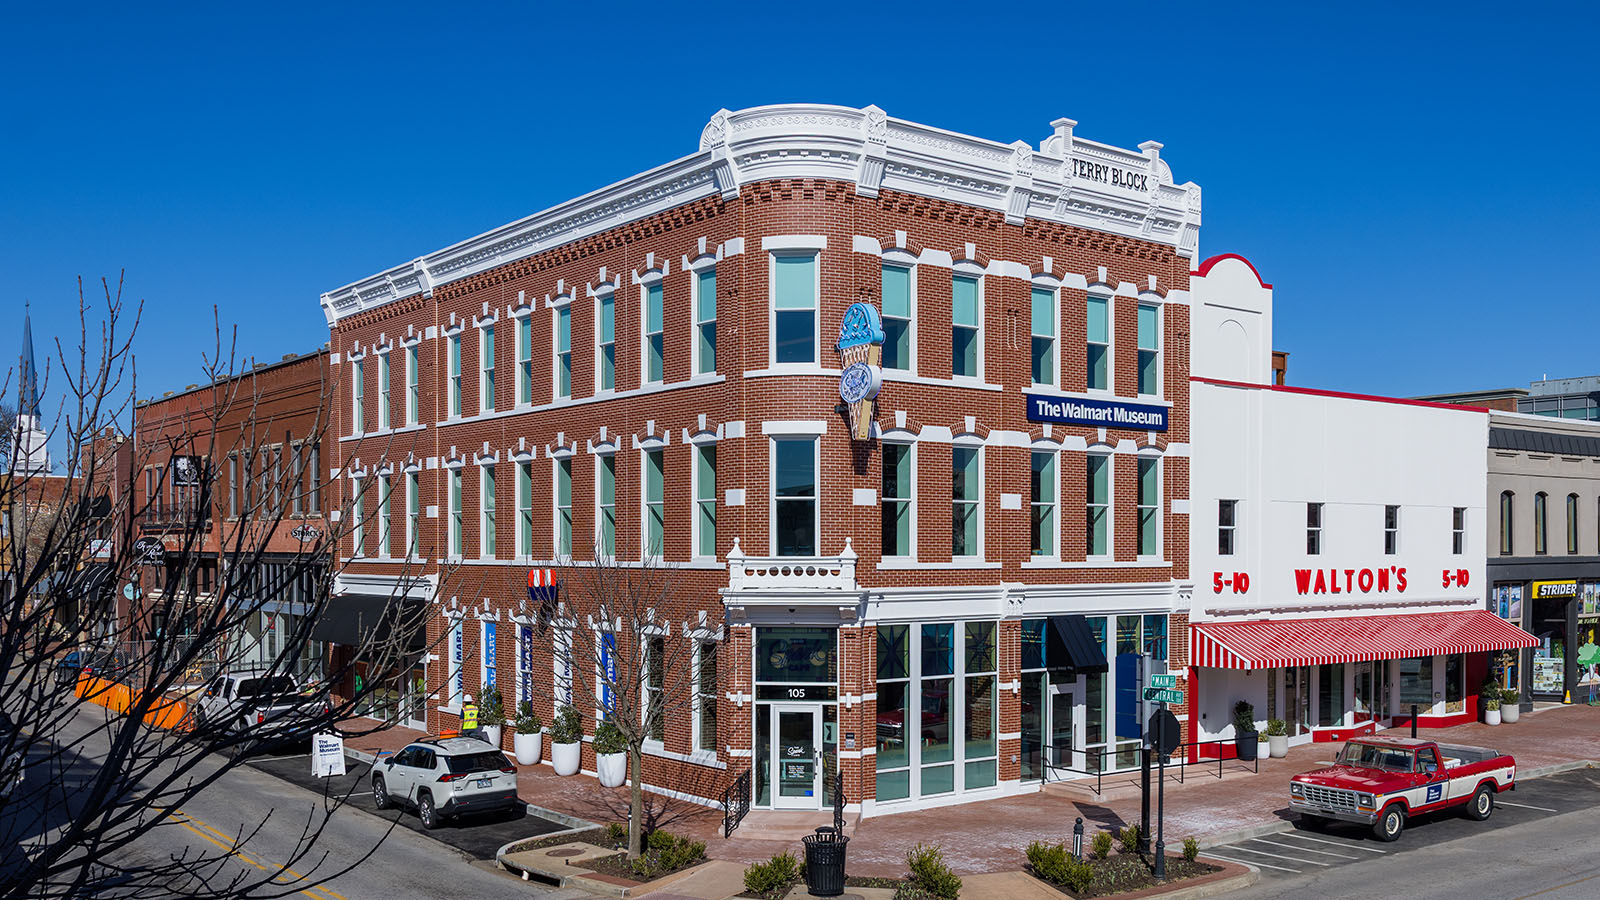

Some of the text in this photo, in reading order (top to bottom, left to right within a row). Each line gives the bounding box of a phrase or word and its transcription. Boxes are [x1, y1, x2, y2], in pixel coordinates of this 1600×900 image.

[1072, 158, 1148, 192] TERRY BLOCK
[1036, 400, 1163, 426] The Walmart Museum
[1213, 571, 1250, 594] 5-10
[1294, 565, 1408, 595] WALTON'S
[1442, 569, 1470, 589] 5-10
[1540, 583, 1577, 597] STRIDER
[1155, 676, 1169, 686] MAIN
[788, 688, 805, 698] 105
